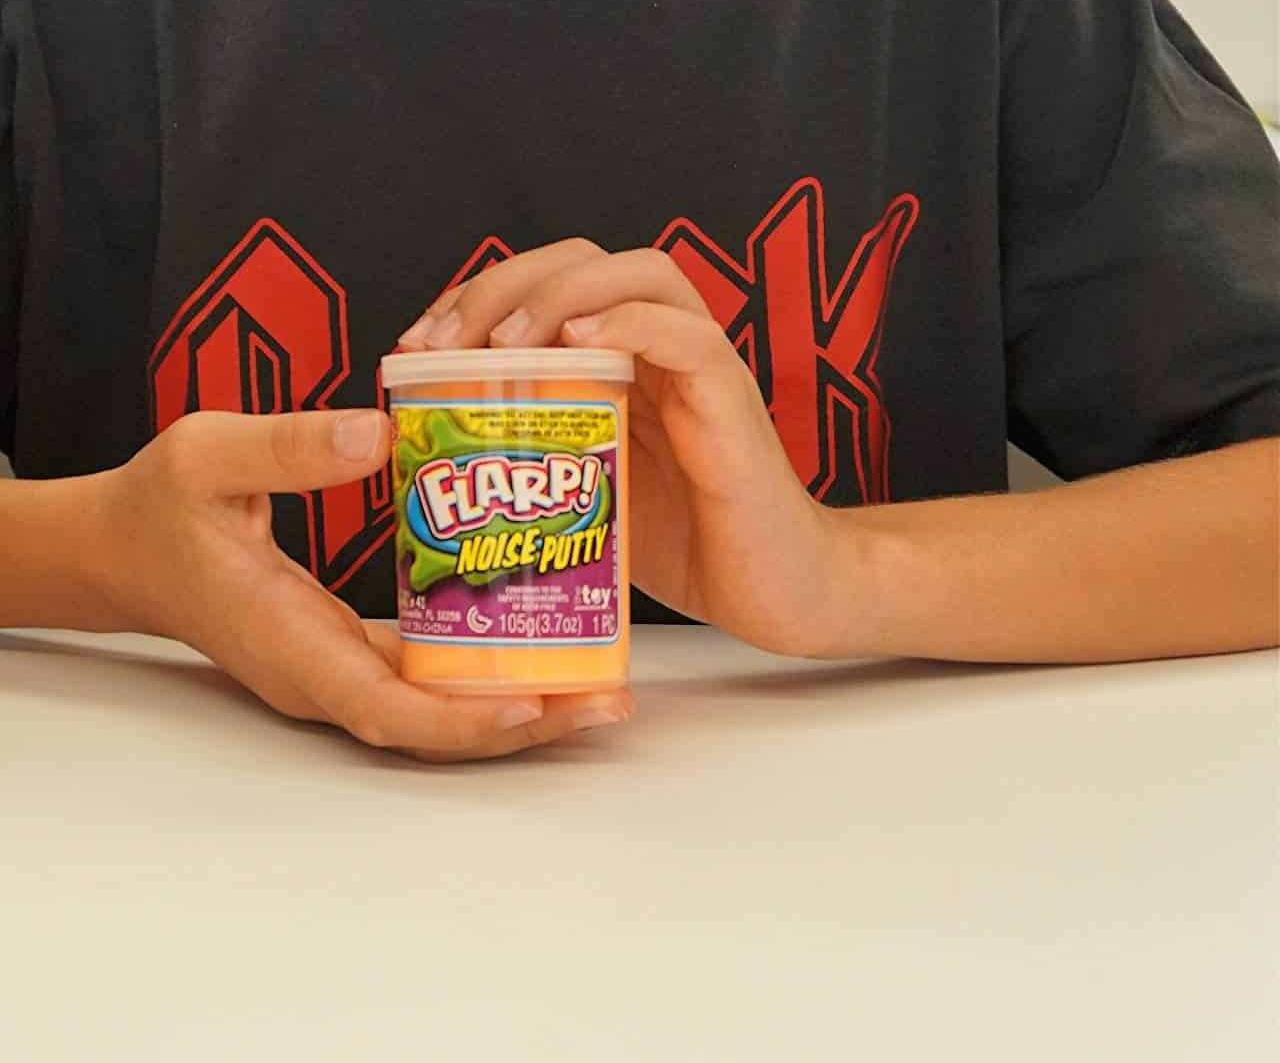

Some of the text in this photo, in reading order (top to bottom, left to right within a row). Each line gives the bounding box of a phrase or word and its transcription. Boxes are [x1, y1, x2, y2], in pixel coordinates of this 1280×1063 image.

[420, 458, 599, 531] FLARP!
[456, 528, 542, 575] NOISE
[538, 523, 609, 574] PUTTY
[498, 612, 583, 638] 105g(3.7oz)
